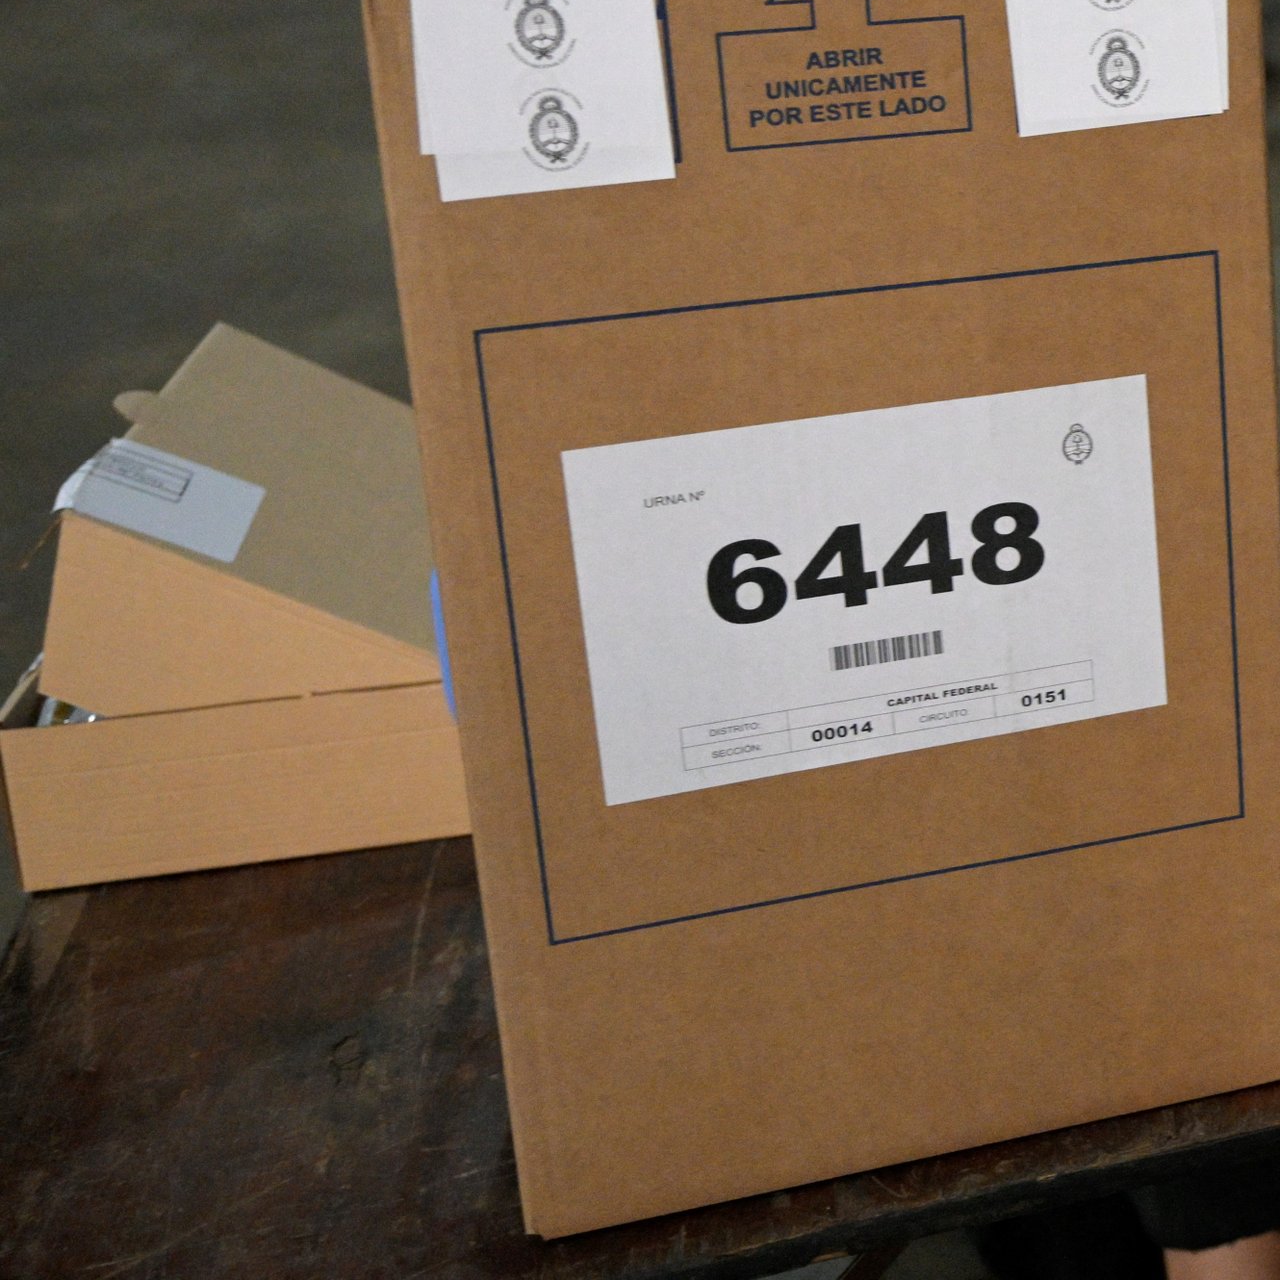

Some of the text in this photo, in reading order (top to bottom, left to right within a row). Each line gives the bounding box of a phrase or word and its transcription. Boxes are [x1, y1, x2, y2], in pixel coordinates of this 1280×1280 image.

[806, 47, 884, 70] ABRIR
[765, 70, 927, 100] UNICAMENTE
[749, 95, 947, 128] POR ESTE LADO
[643, 493, 688, 509] URNA
[706, 501, 1046, 625] 6448
[887, 683, 999, 708] CAPITAL FEDERAL
[1021, 689, 1067, 708] 0151
[811, 721, 874, 743] 00014
